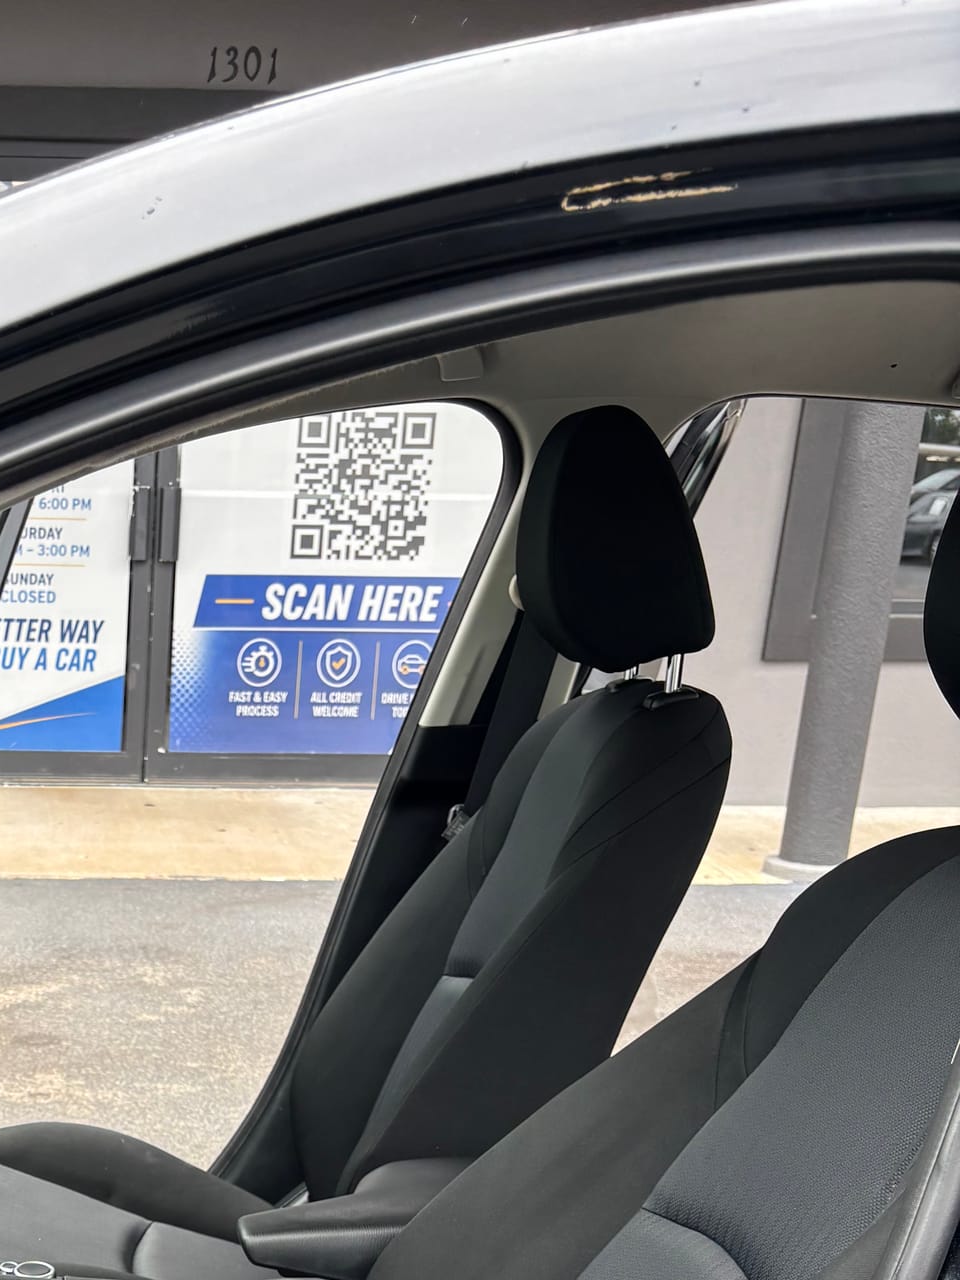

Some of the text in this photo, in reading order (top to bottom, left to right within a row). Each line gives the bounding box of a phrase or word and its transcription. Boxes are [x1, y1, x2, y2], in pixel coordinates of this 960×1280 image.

[207, 46, 278, 84] 1301
[39, 497, 92, 511] 6:00 PM
[22, 527, 63, 540] URDAY
[38, 544, 68, 557] 3:00
[71, 545, 90, 558] PM
[5, 573, 54, 586] UNDAY
[1, 590, 57, 604] CLOSED
[261, 583, 444, 622] SCAN HERE
[60, 620, 105, 643] WAY
[34, 647, 48, 671] A
[55, 648, 97, 672] CAR
[229, 691, 288, 703] FAST & EASY
[310, 692, 362, 704] ALL CREDIT
[236, 705, 280, 717] PROCESS
[312, 705, 359, 718] WELCOME
